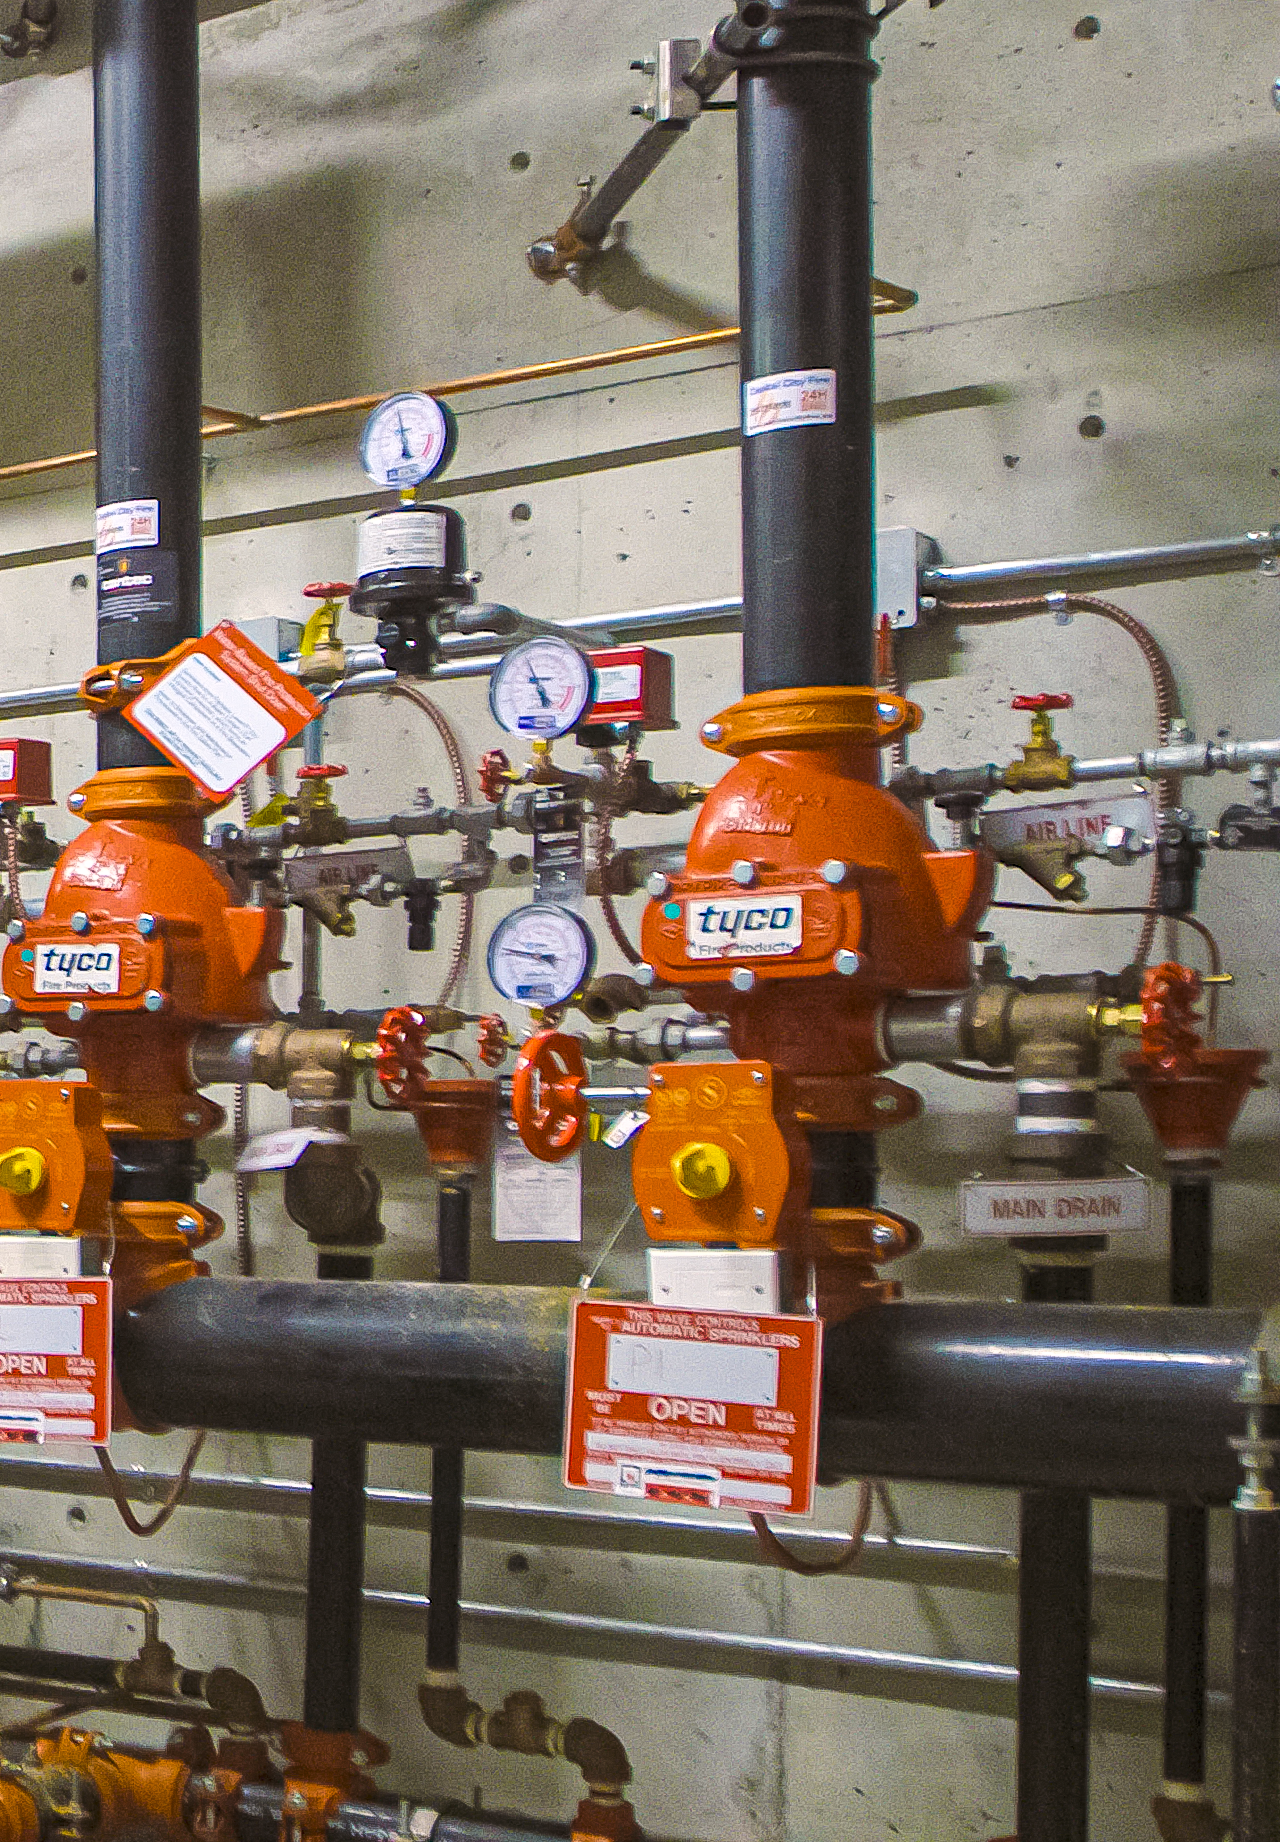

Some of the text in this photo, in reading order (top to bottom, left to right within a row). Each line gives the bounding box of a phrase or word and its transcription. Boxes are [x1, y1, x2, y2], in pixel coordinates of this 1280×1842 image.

[697, 905, 794, 938] tyco
[42, 948, 112, 978] tyco
[992, 1196, 1121, 1220] MAIN DRAIN
[621, 1320, 801, 1349] AUTOMATIC SPRINKLERS
[648, 1396, 727, 1427] OPEN
